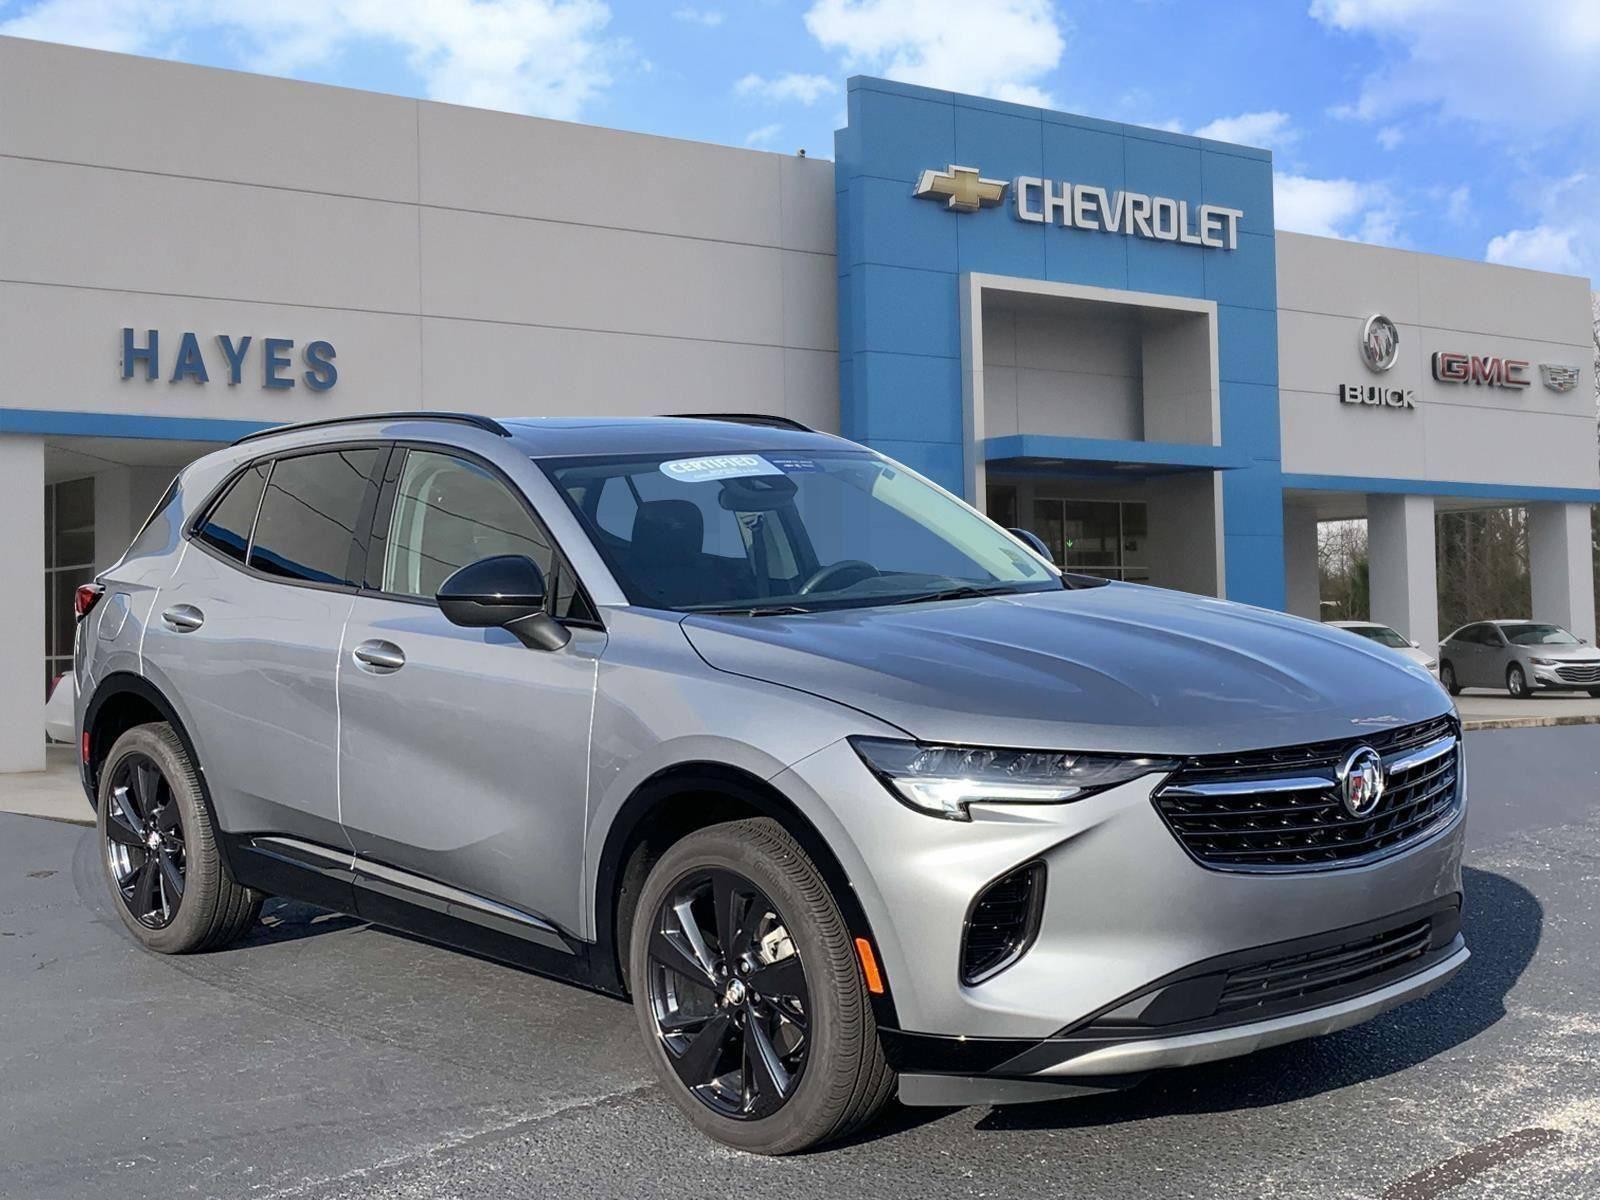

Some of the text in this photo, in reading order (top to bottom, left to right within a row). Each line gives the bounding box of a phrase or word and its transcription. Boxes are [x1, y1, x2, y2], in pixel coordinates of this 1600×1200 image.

[1015, 175, 1243, 250] CHEVROLET
[121, 328, 338, 391] HAYES
[1432, 351, 1531, 390] GMC
[1339, 384, 1416, 409] BUICK
[667, 456, 759, 474] CERTIFIED
